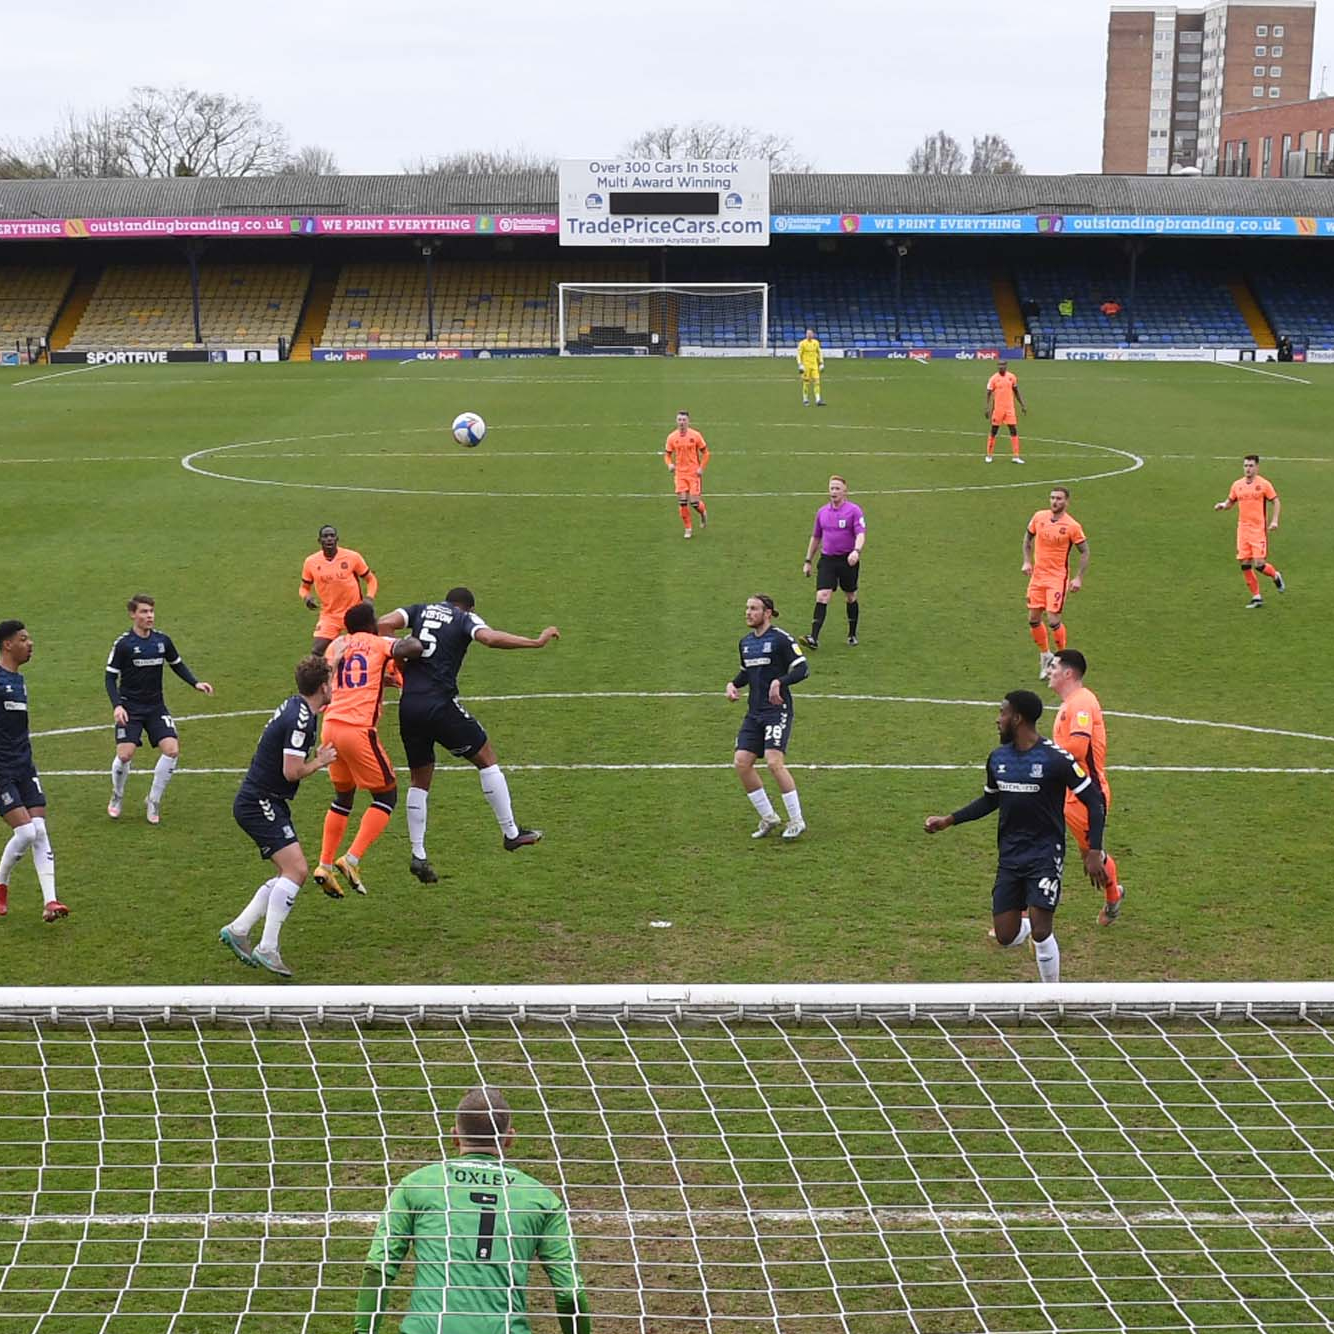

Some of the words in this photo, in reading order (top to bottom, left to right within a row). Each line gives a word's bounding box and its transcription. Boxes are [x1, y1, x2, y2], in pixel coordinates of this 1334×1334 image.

[589, 162, 620, 173] Over
[626, 162, 651, 173] 300
[654, 162, 683, 173] Cars
[687, 162, 698, 173] In
[703, 161, 738, 173] Stock
[597, 177, 628, 188] Multi
[632, 177, 673, 188] Award
[677, 176, 731, 190] Winning
[90, 219, 283, 234] outstandingbranding.co.uk
[322, 220, 342, 230] WE
[346, 220, 384, 230] PRINT
[388, 219, 471, 230] EVERYTHING
[566, 216, 763, 234] TradePriceCars.com
[874, 219, 894, 229] WE
[898, 219, 936, 229] PRINT
[939, 219, 1022, 230] EVERYTHING
[1073, 218, 1282, 233] outstandingbranding.co.uk
[86, 351, 167, 364] SPORTFIVE
[1054, 592, 1061, 602] 9
[419, 620, 442, 658] 5
[337, 653, 368, 689] 10
[764, 725, 783, 740] 28
[455, 1170, 515, 1185] OXLEY
[469, 1191, 498, 1260] 1
